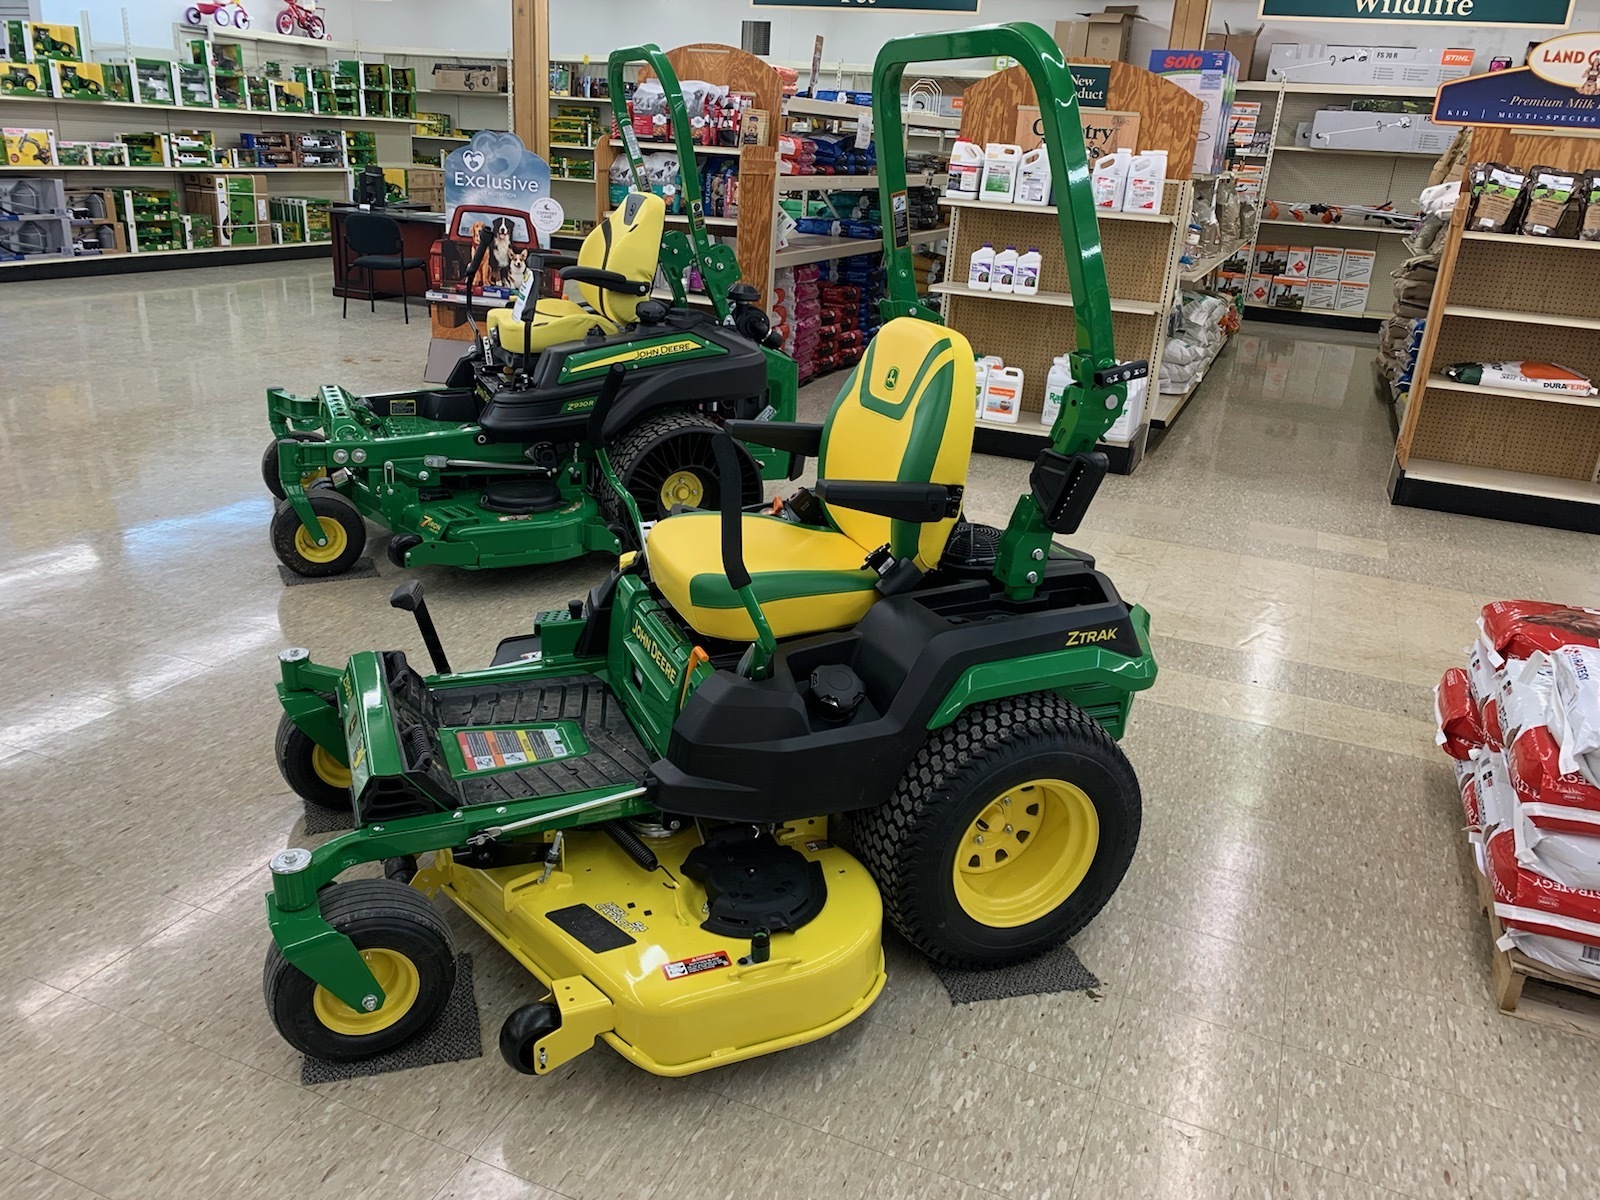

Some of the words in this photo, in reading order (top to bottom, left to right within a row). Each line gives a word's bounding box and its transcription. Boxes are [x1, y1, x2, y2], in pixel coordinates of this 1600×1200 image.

[1355, 0, 1474, 16] Wildlife
[1163, 53, 1203, 69] solo
[1444, 54, 1471, 62] STIHL
[1543, 49, 1585, 64] LAND
[1071, 74, 1096, 87] New
[1509, 96, 1564, 108] Premium
[1566, 98, 1595, 109] Milk
[1447, 109, 1469, 117] KID
[1498, 111, 1596, 123] MULTI-SPECIES
[454, 171, 539, 193] Exclusive
[634, 347, 659, 360] JOHN
[661, 343, 691, 357] DEERE
[567, 400, 595, 411] Z930R
[1065, 627, 1118, 646] ZTRAK
[632, 619, 651, 653] JOHN
[651, 643, 677, 685] DEERE
